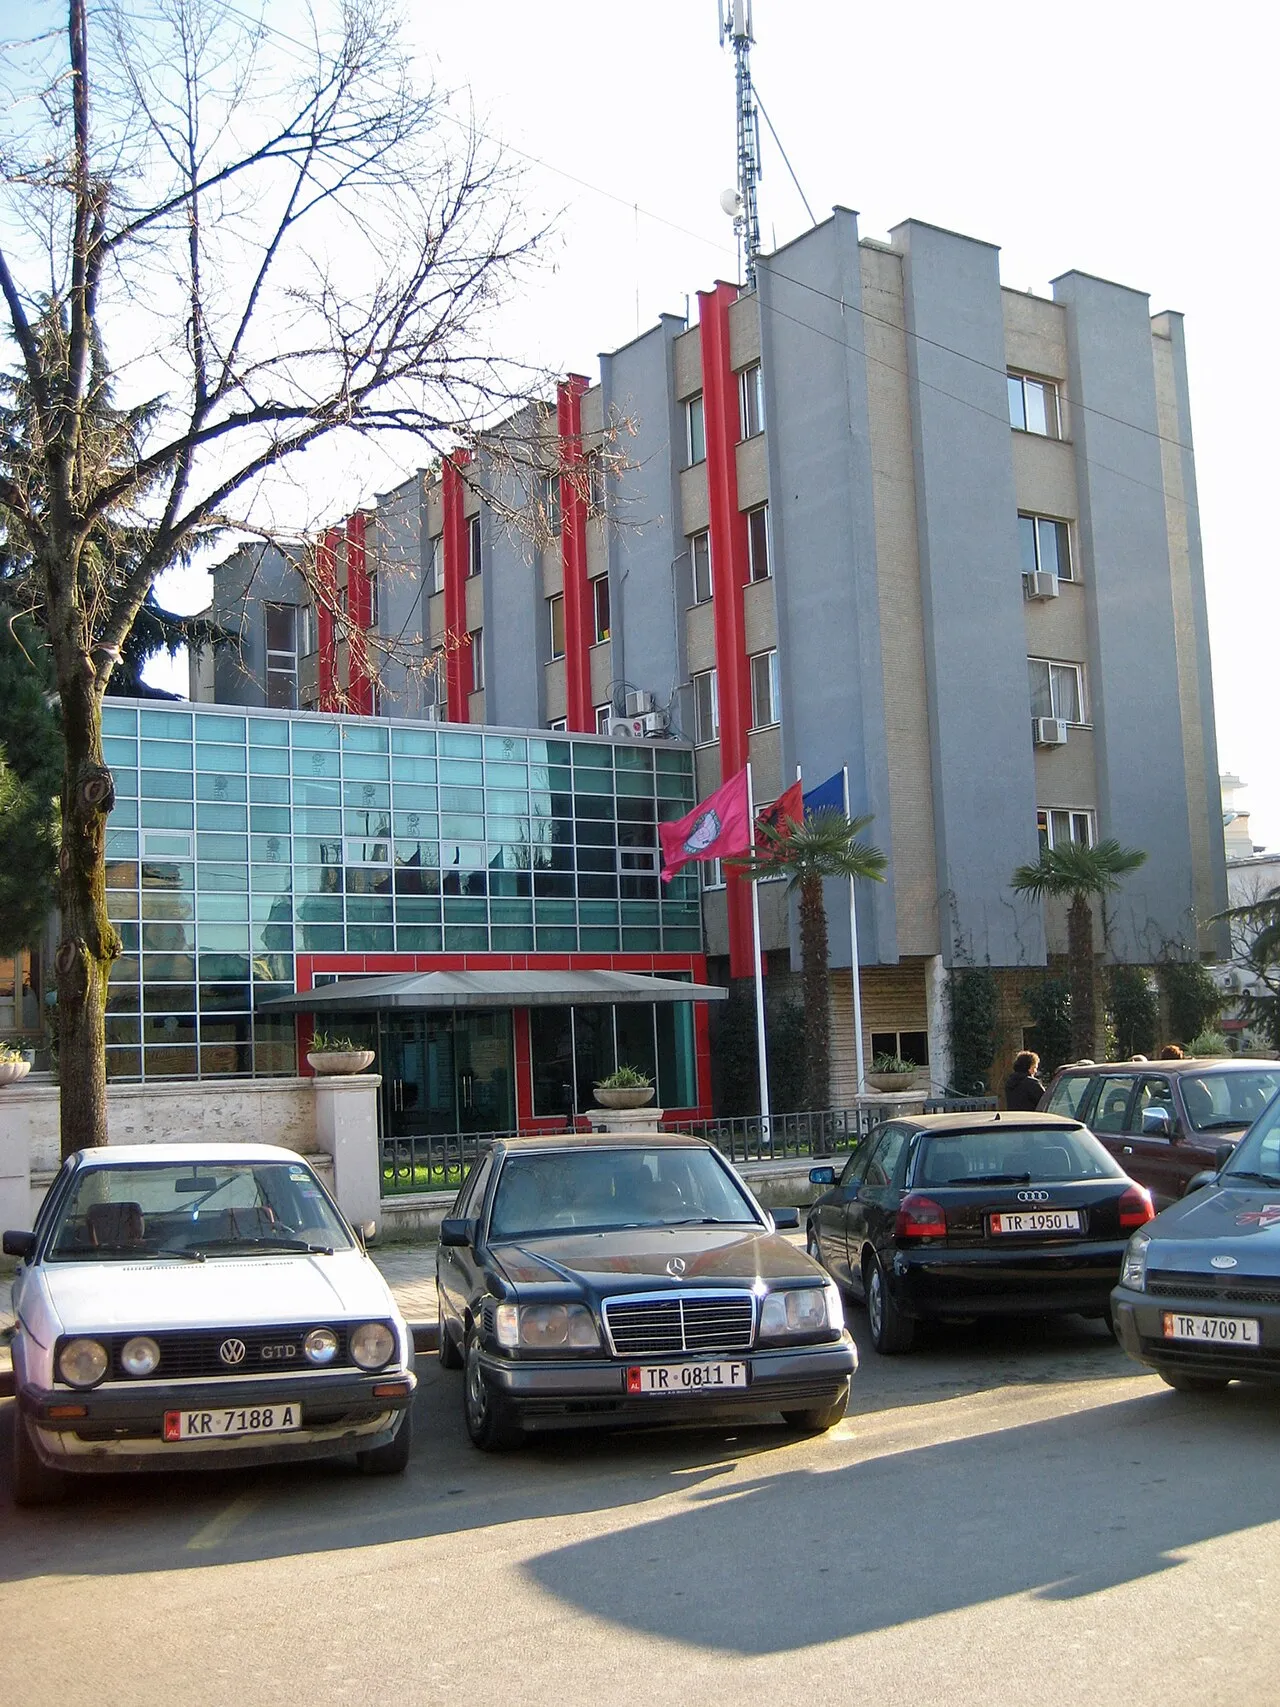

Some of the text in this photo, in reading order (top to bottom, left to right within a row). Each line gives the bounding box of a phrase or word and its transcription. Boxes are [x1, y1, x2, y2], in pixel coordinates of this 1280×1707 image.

[1005, 1214, 1074, 1230] TR 1950 L
[1177, 1317, 1251, 1341] TR 4709 L
[261, 1344, 297, 1359] GTD
[647, 1364, 740, 1389] TR 0811 F
[187, 1406, 294, 1434] KR 7188 A
